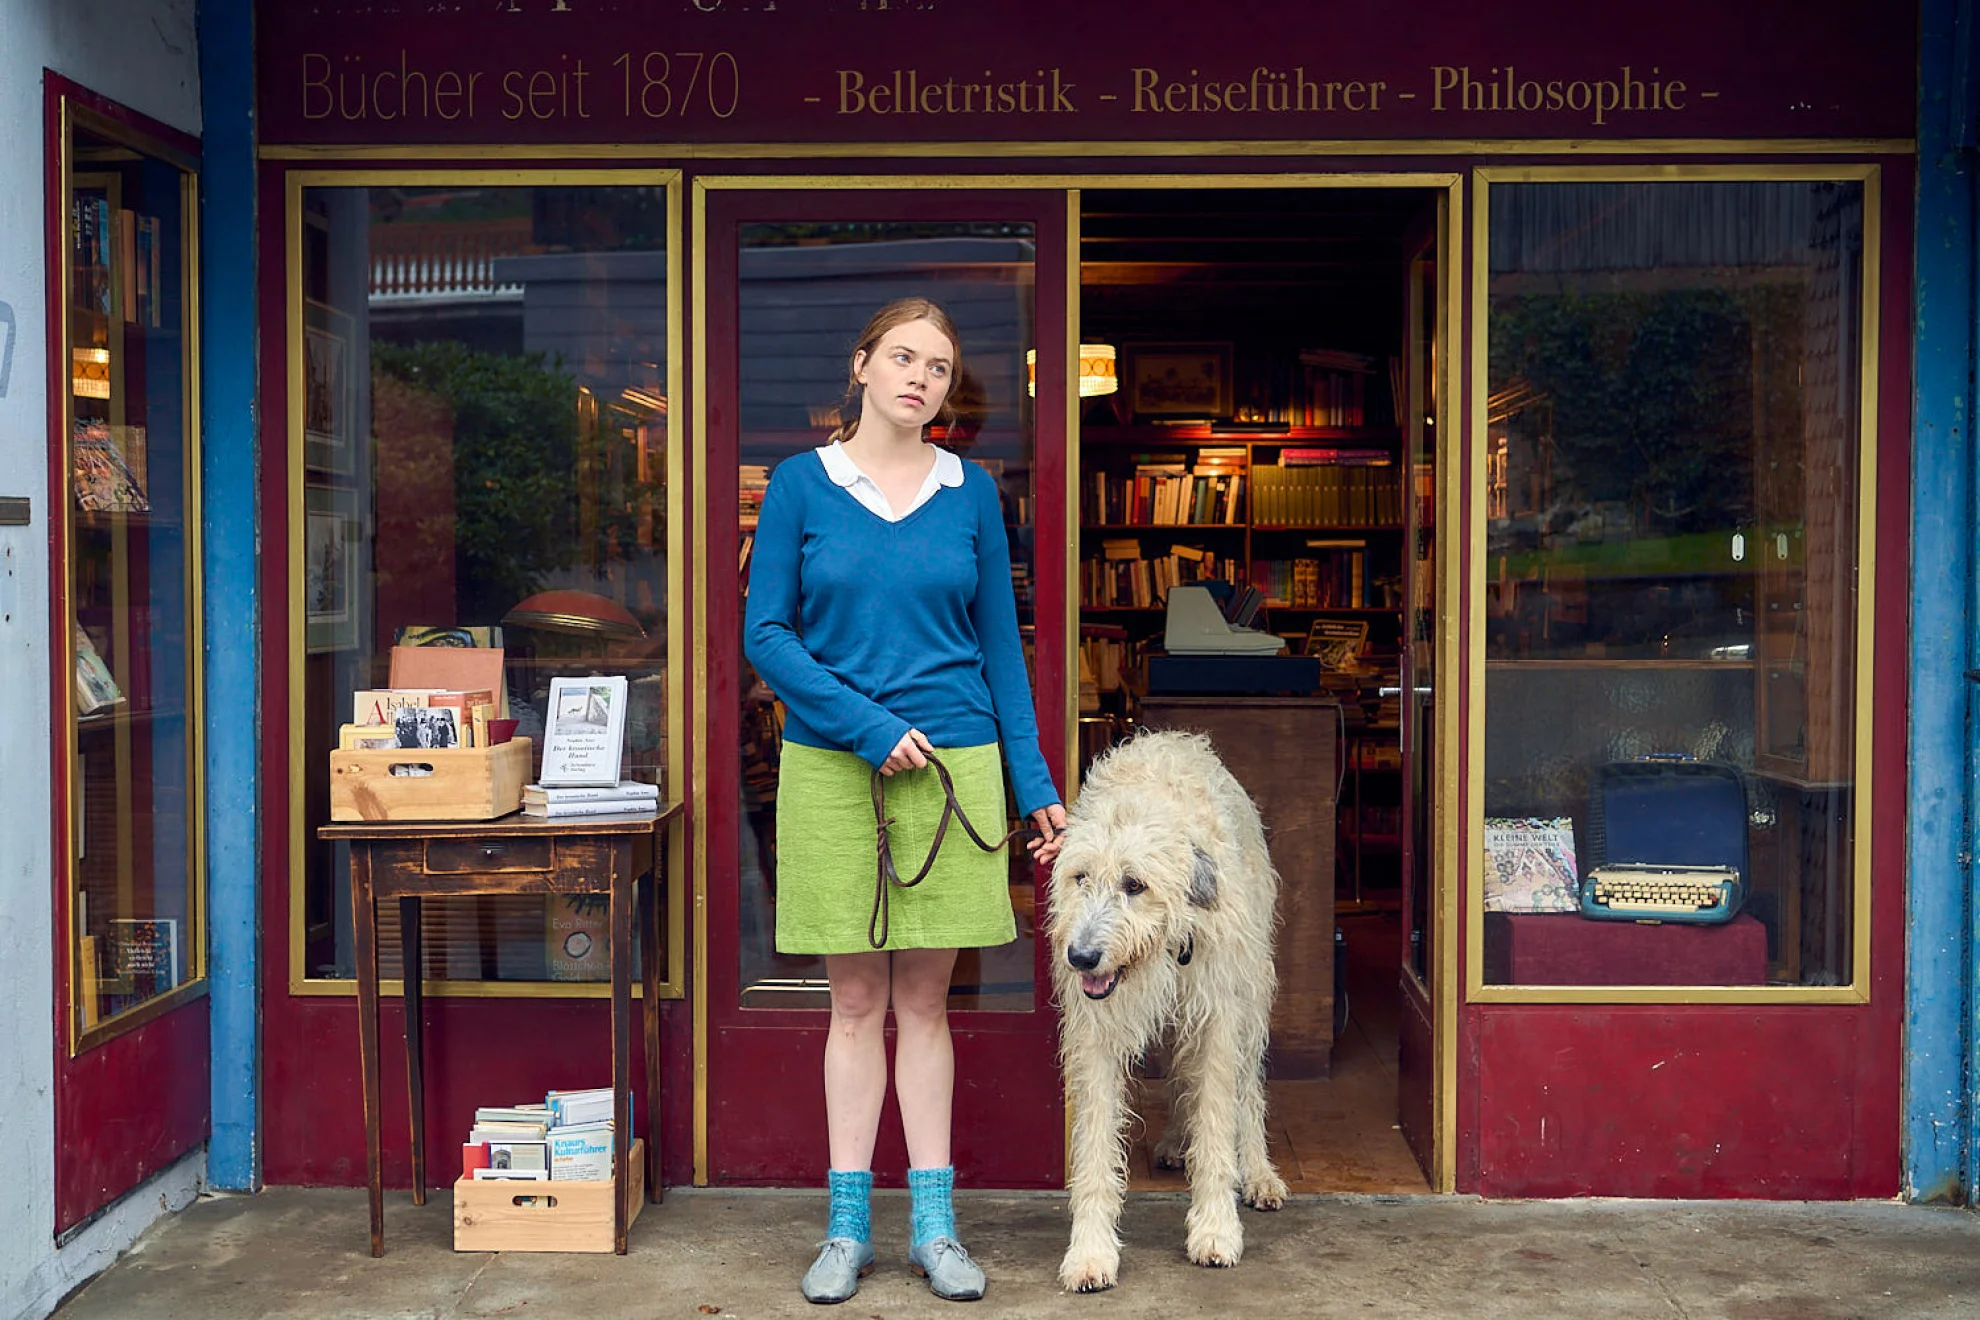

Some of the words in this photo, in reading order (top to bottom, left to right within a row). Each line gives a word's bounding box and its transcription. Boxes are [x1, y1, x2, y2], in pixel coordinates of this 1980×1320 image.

[302, 49, 484, 120] Bücher
[502, 53, 591, 120] seit
[613, 51, 739, 118] 1870
[836, 69, 1077, 115] Belletristik
[1130, 67, 1387, 112] Reiseführer
[1430, 66, 1687, 125] Philosophie
